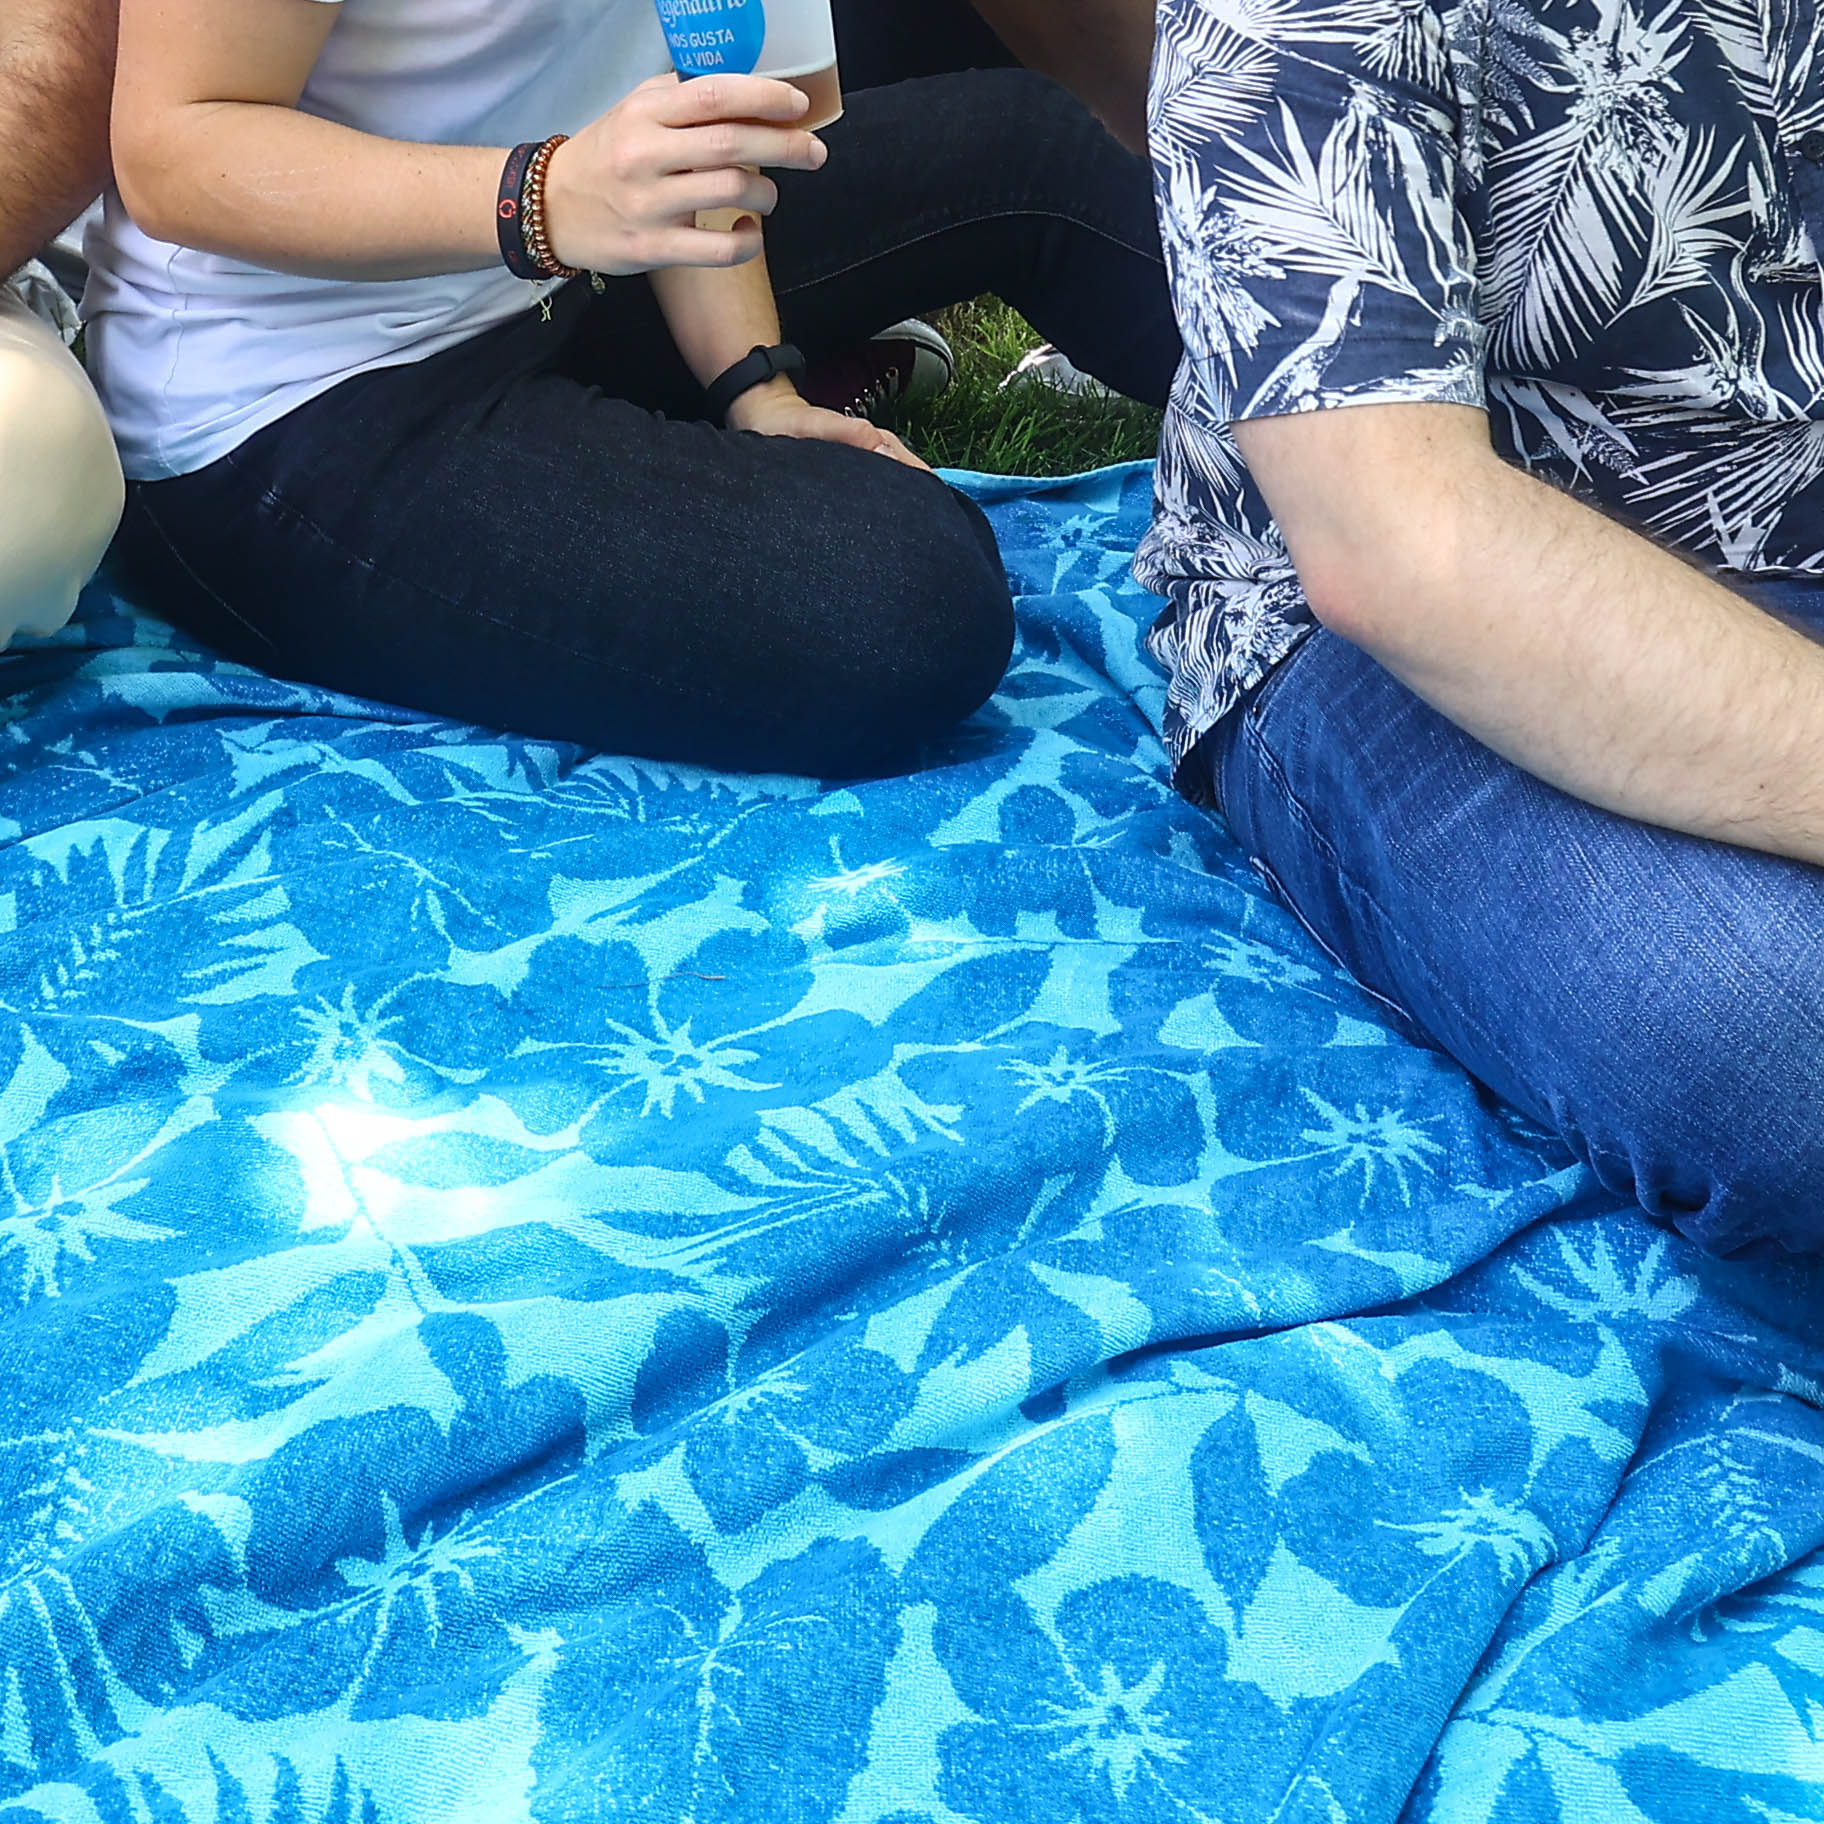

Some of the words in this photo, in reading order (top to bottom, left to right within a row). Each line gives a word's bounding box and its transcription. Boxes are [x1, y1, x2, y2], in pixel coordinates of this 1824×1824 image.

[689, 28, 735, 48] GUSTA
[679, 52, 694, 68] LA
[693, 50, 725, 68] VIDA
